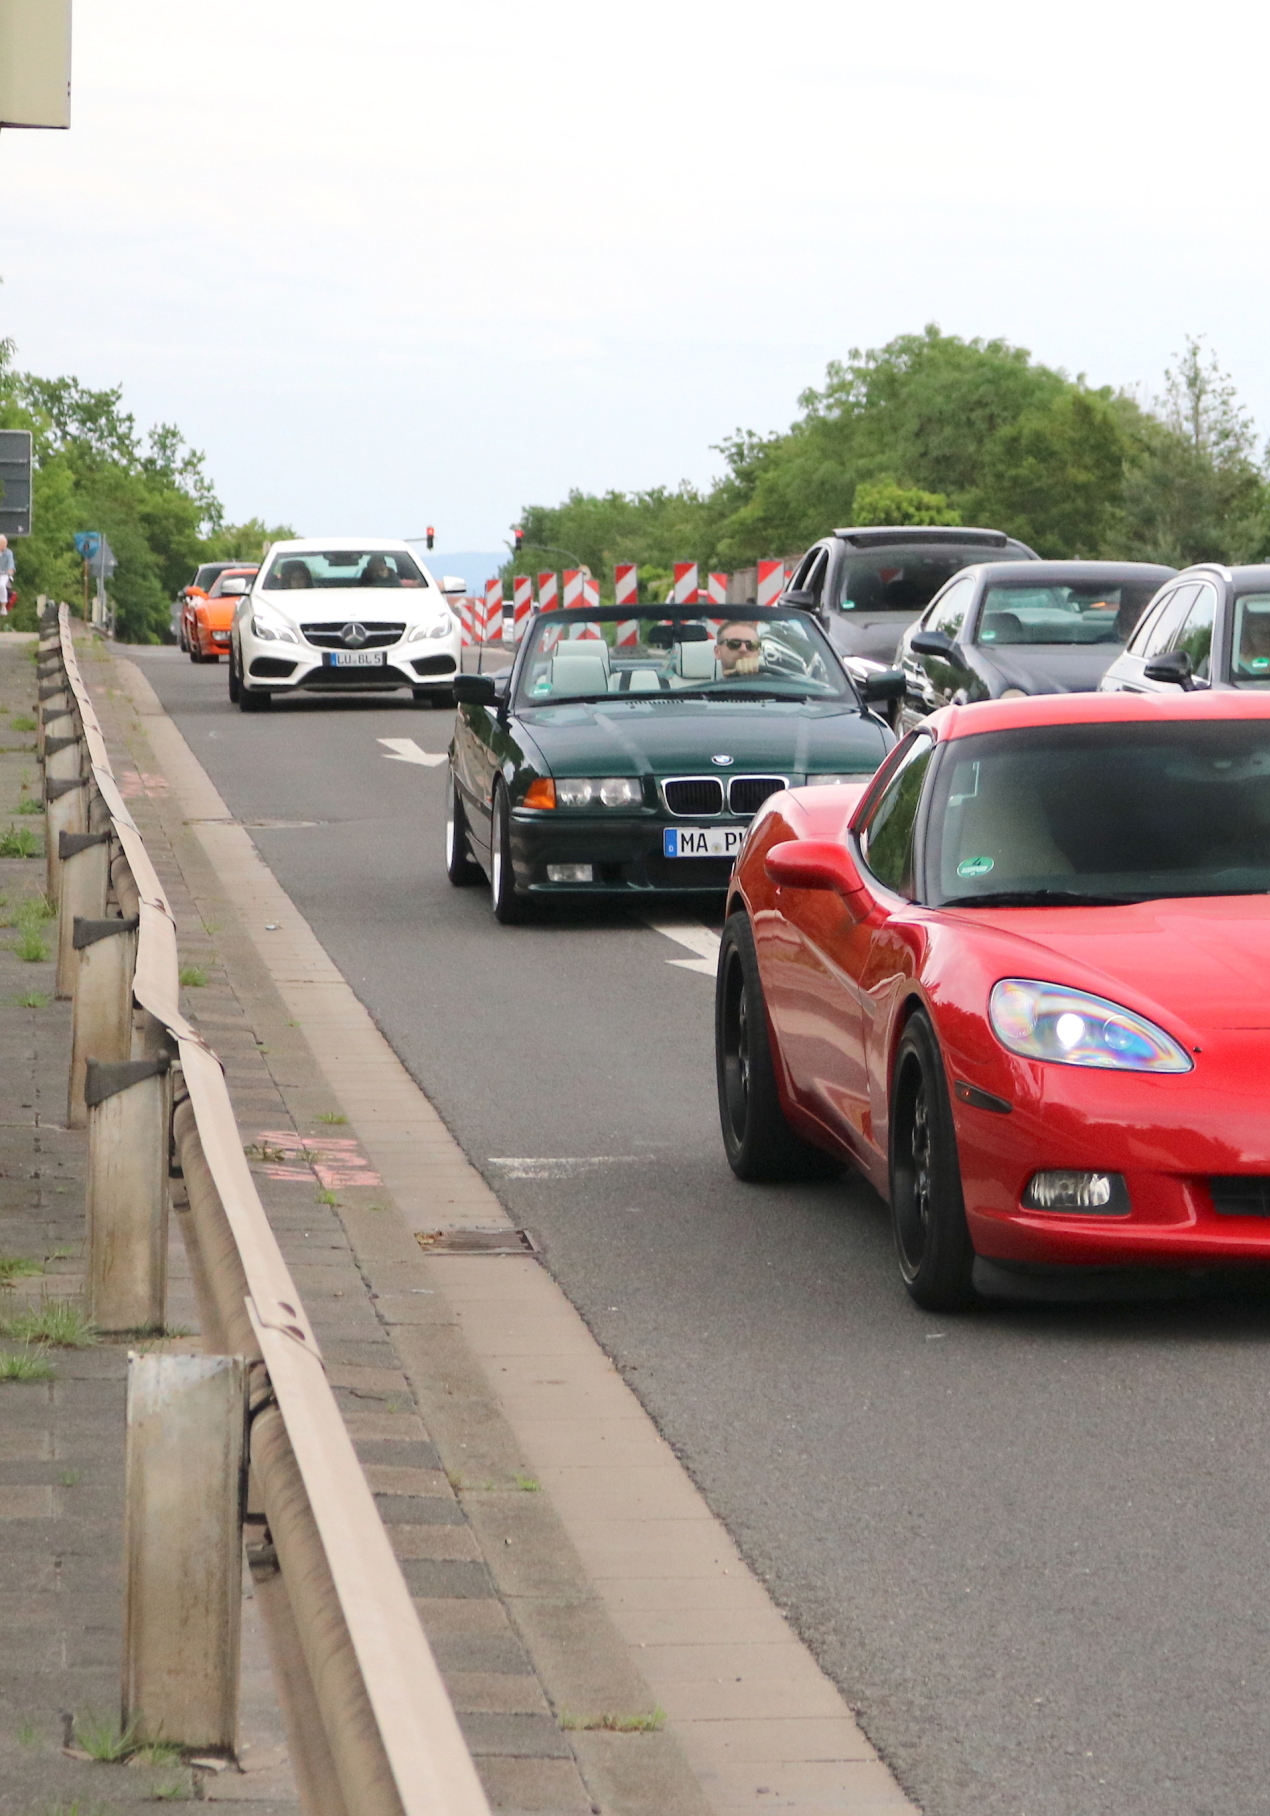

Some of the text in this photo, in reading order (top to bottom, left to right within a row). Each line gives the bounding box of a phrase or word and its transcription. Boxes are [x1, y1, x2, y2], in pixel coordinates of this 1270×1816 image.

[337, 654, 351, 664] LU
[358, 654, 372, 664] BL
[680, 832, 743, 853] MA P
